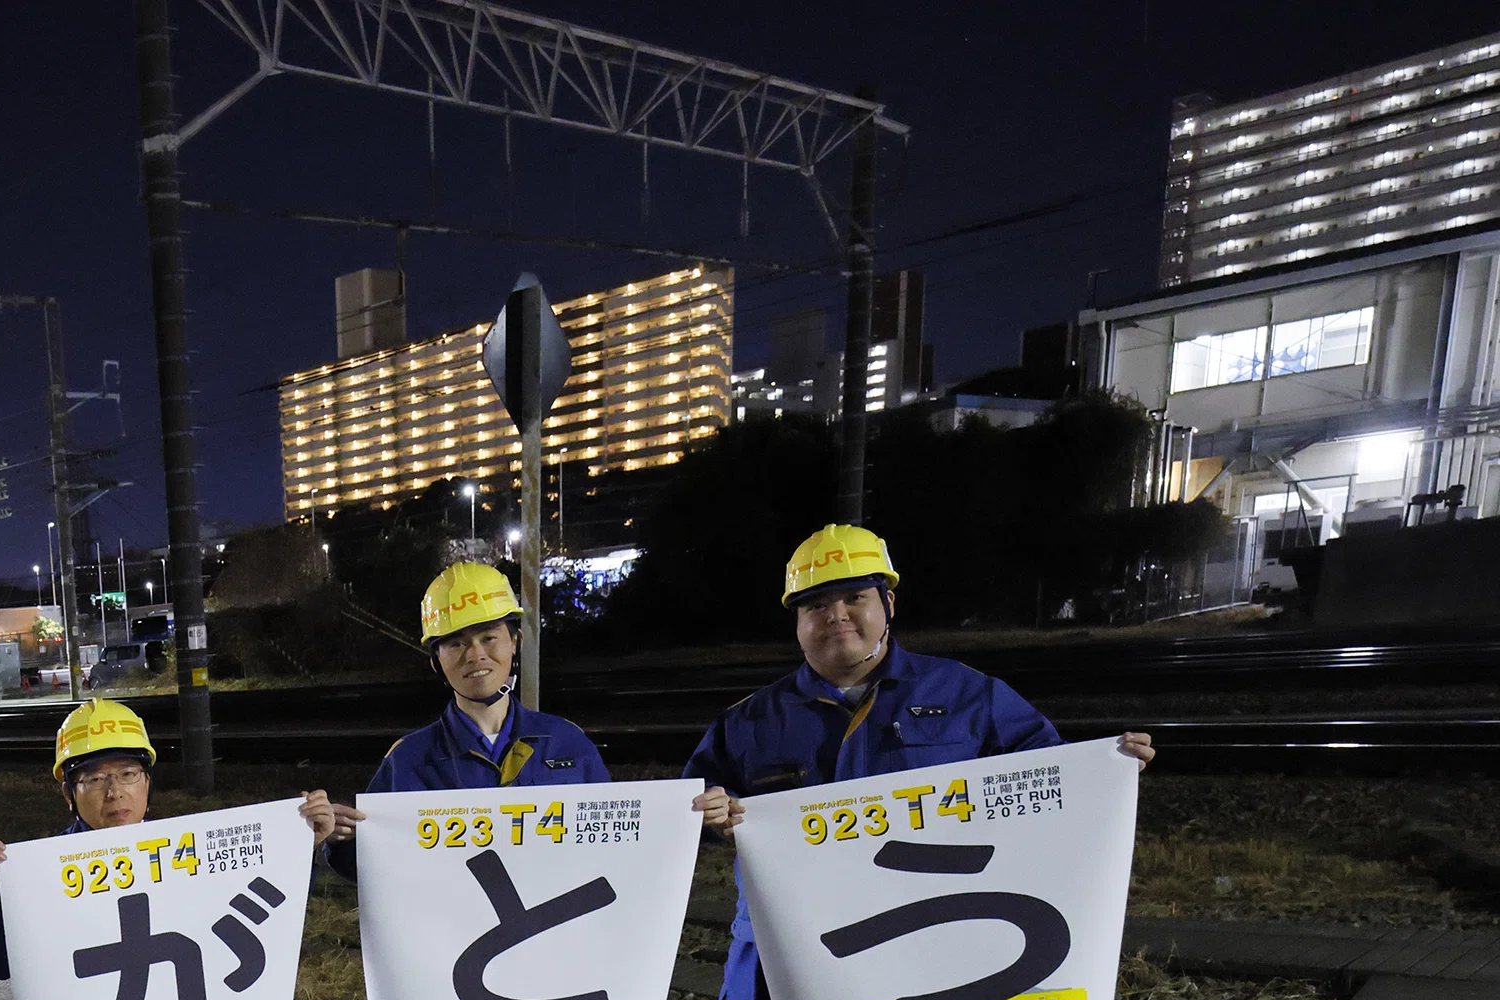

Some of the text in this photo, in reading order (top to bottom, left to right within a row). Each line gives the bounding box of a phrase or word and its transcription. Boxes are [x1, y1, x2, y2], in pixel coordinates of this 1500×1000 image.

[814, 549, 844, 568] JR
[451, 591, 479, 611] JR
[90, 720, 117, 736] JR
[982, 765, 1060, 786] 東海道新幹線
[577, 800, 641, 811] 東海道新幹線
[800, 797, 857, 813] SHINKANSEN
[985, 788, 1062, 809] LAST RUN
[417, 807, 470, 817] SHINKANSEN
[801, 777, 976, 846] 923 T4
[986, 799, 1063, 821] 2025.1
[206, 822, 262, 840] 東海道新幹線
[417, 801, 568, 849] 923 T4
[576, 821, 640, 833] LAST RUN
[576, 832, 640, 844] 2025.1
[59, 848, 108, 863] SHINKANSEN
[207, 844, 263, 862] LAST RUN
[61, 832, 201, 898] 923 T4
[208, 854, 265, 874] 2025.1
